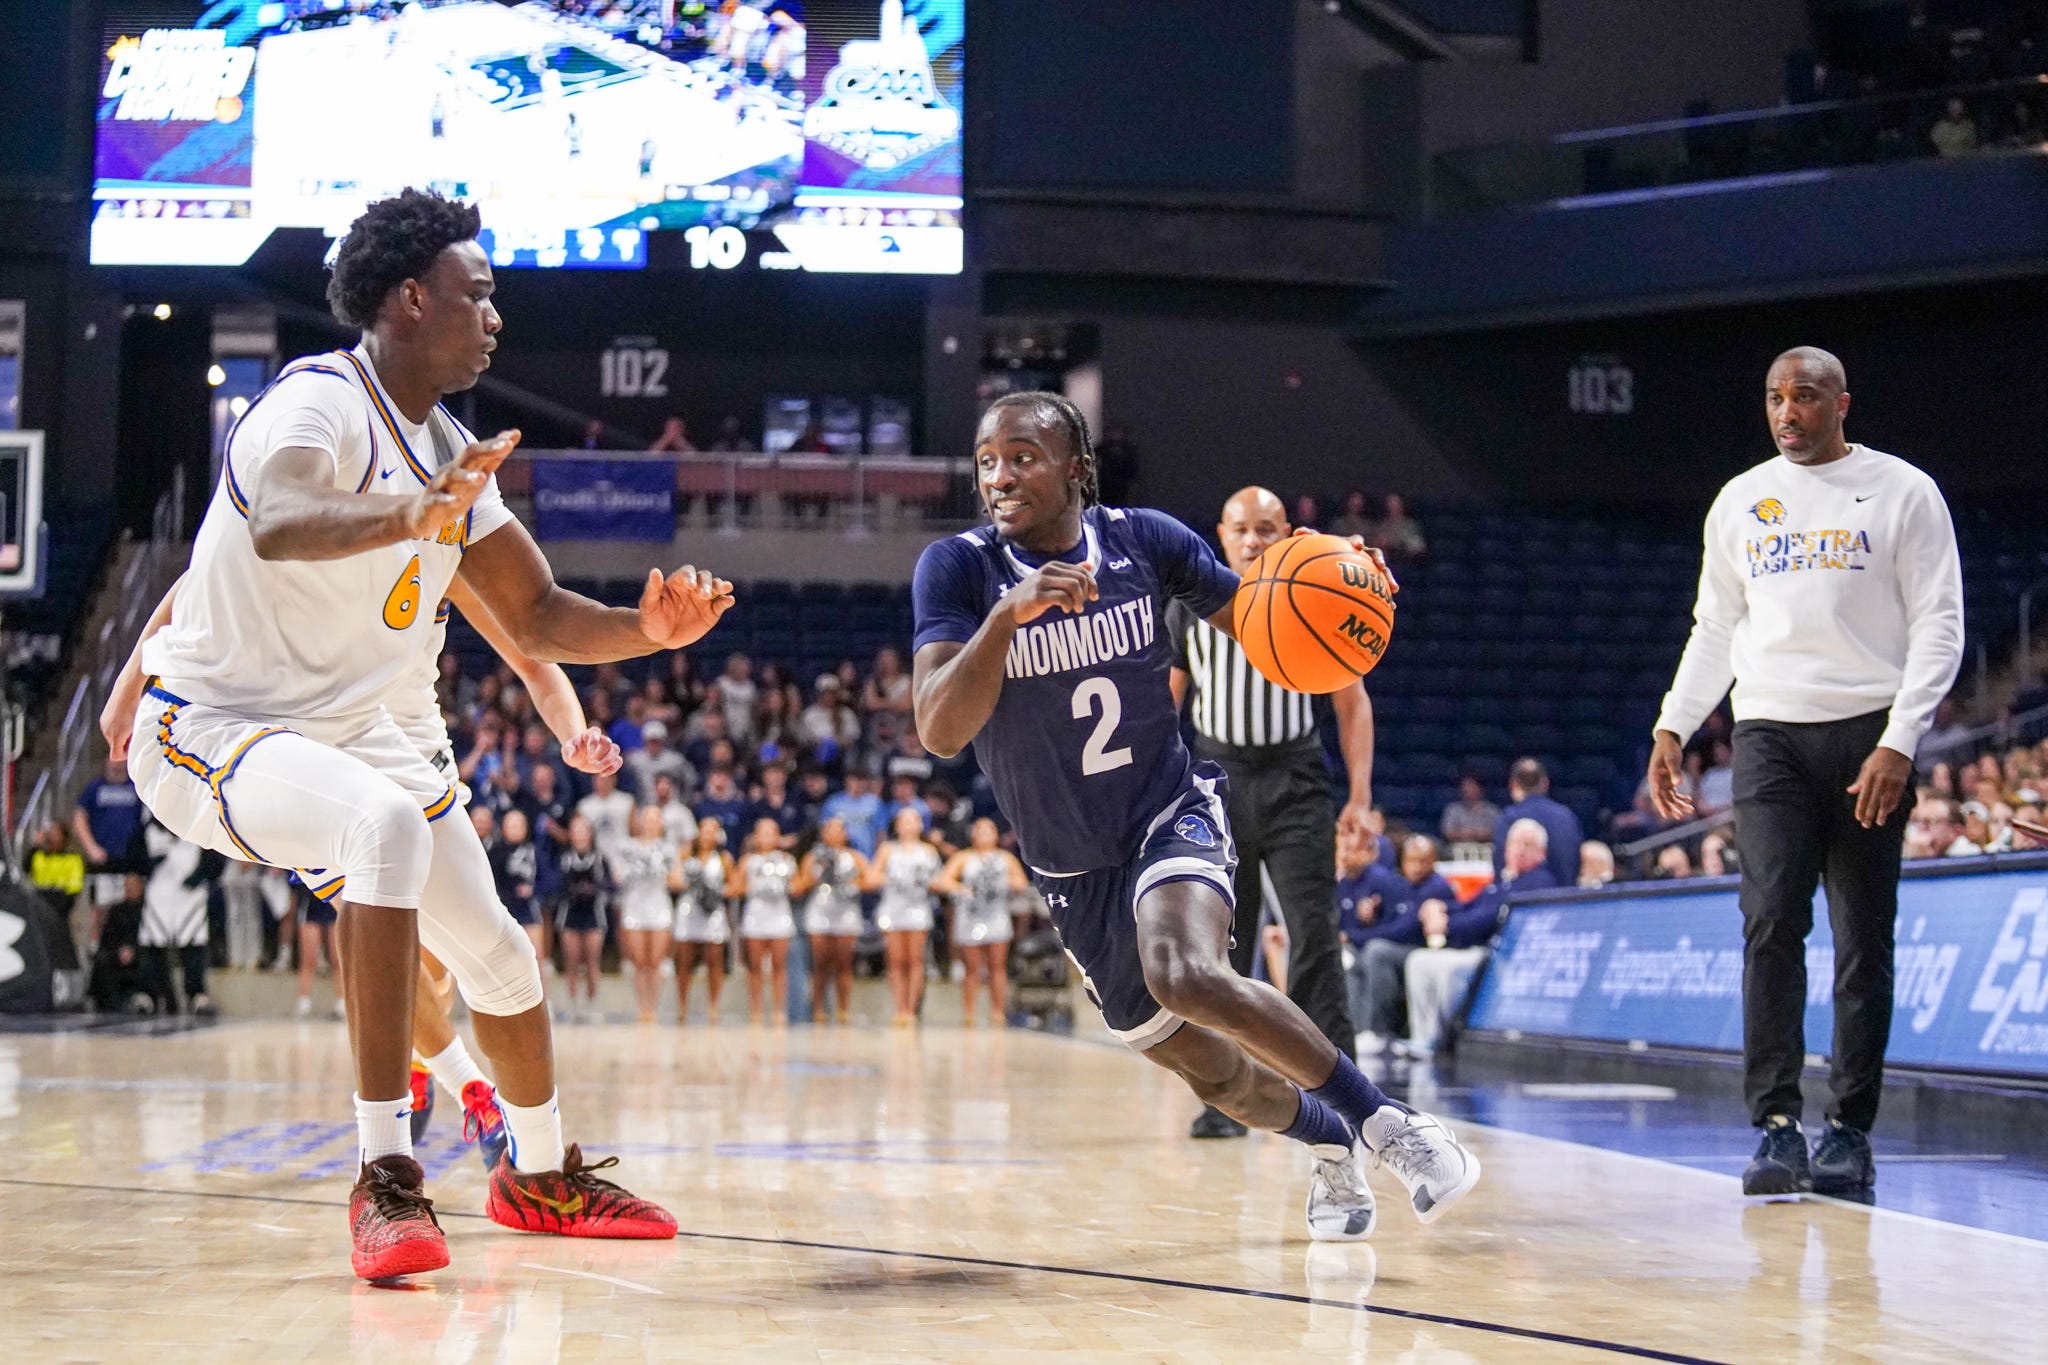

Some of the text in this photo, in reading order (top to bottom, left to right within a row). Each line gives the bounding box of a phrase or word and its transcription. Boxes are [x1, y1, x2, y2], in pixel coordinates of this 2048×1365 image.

[684, 226, 747, 269] 10
[601, 349, 669, 397] 102
[1567, 366, 1633, 414] 103
[1109, 557, 1132, 570] CAA
[1746, 529, 1871, 562] HOFSTRA
[1751, 553, 1865, 578] BASKETBALL
[383, 553, 420, 630] 6
[1005, 594, 1154, 679] MONMOUTH
[1071, 676, 1133, 776] 2
